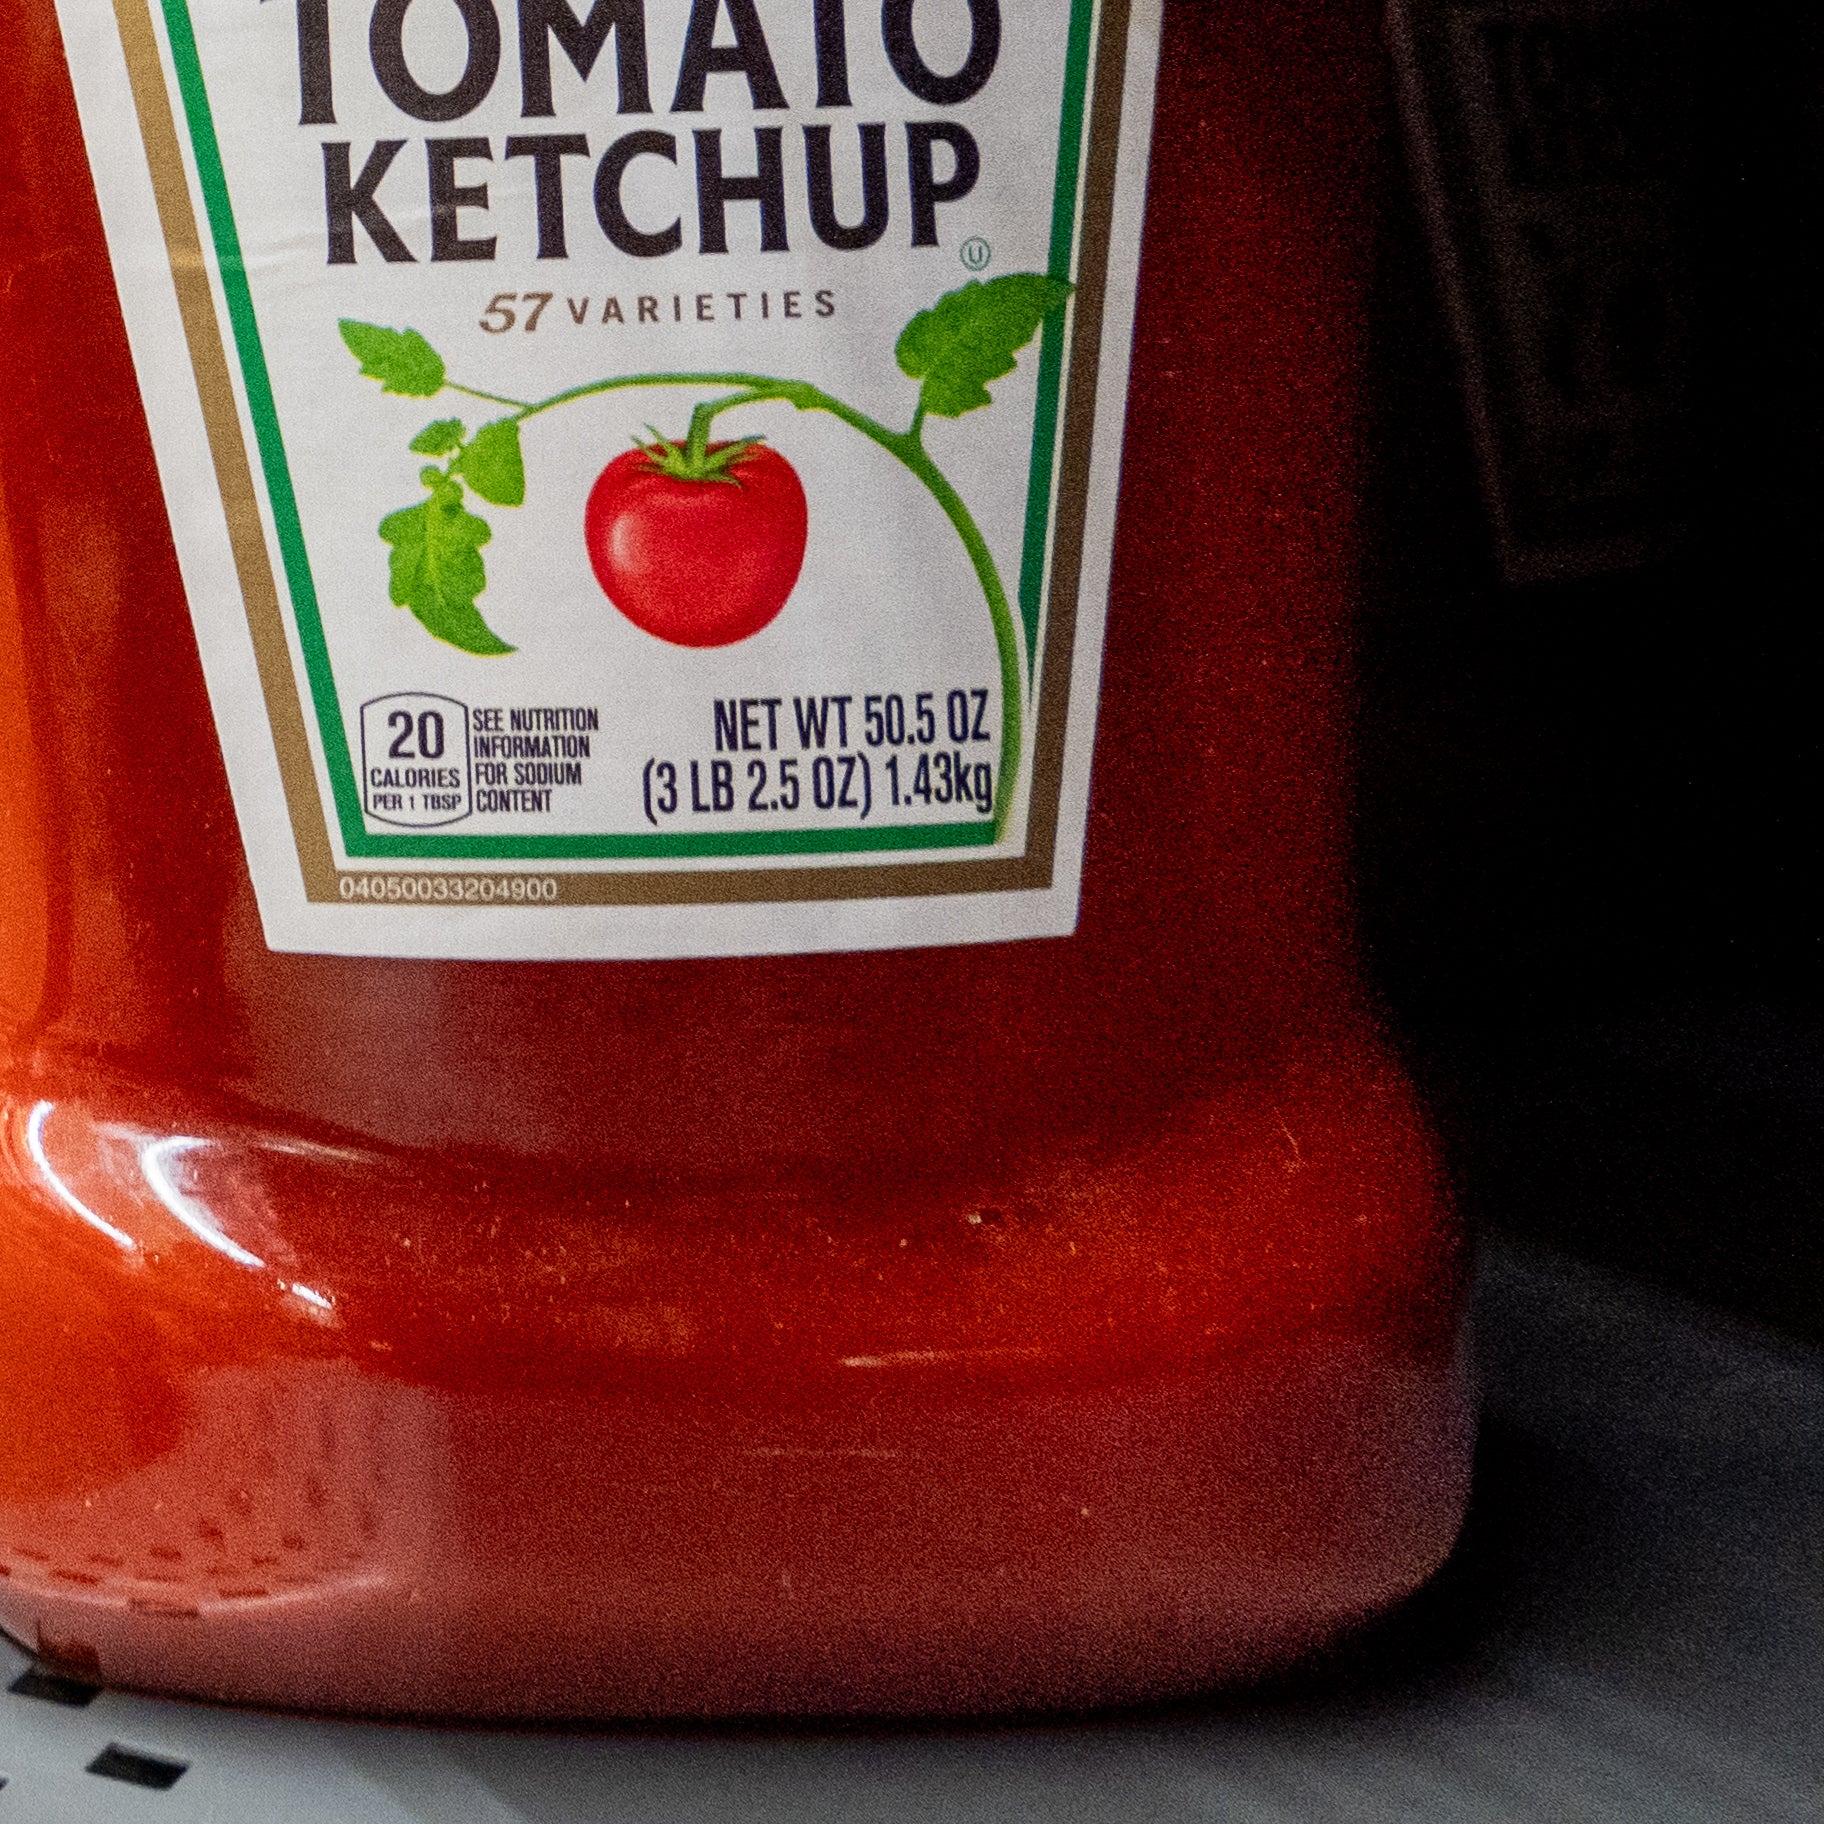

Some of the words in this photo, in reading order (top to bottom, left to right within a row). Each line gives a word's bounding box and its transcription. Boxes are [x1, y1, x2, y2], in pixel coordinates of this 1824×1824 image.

[321, 120, 981, 266] KETCHUP
[479, 291, 553, 334] 57
[567, 289, 837, 325] VARIETIES
[472, 708, 503, 732] SEE
[510, 706, 599, 732] NUTRITION
[713, 697, 783, 752] NET
[794, 695, 853, 750] WT
[864, 691, 936, 747] 50.5
[947, 688, 991, 744] OZ
[387, 709, 445, 760] 20
[473, 734, 591, 759] INFORMATION
[370, 767, 461, 789] CALORIES
[475, 763, 508, 786] FOR
[514, 761, 582, 786] SODIUM
[372, 793, 402, 811] PER
[409, 794, 416, 810] 1
[422, 792, 462, 811] TBSP
[475, 788, 553, 813] CONTENT
[642, 757, 678, 827] (3
[690, 759, 735, 814] LB
[747, 758, 801, 813] 2.5
[812, 751, 873, 821] OZ)
[885, 750, 994, 815] 1.43kg
[339, 876, 558, 902] 04050033204900
